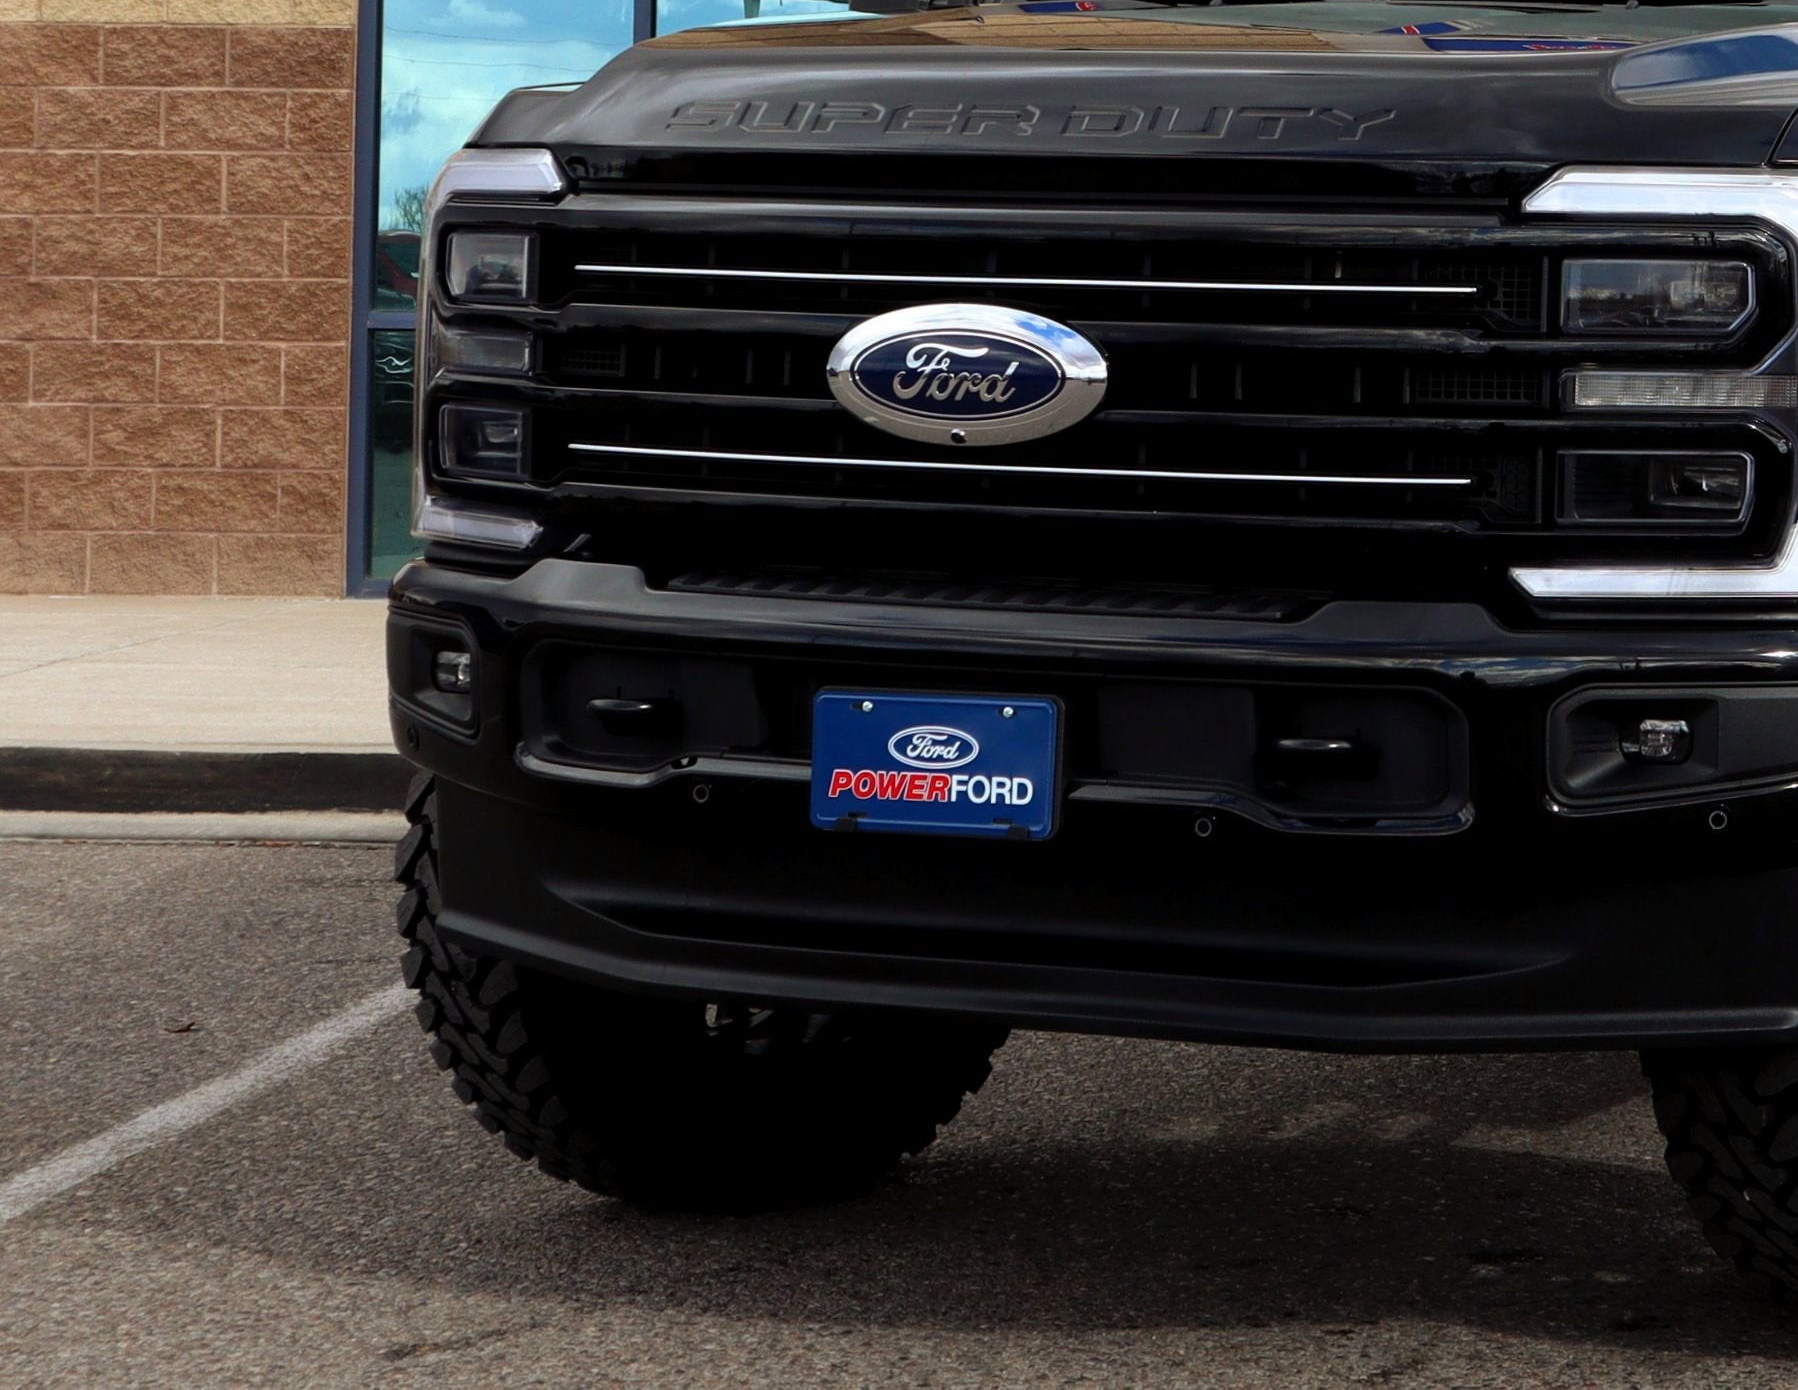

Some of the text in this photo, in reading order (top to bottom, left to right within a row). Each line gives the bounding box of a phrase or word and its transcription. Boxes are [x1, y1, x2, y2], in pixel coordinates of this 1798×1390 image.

[665, 99, 1398, 142] SUPER DUTY
[892, 342, 1020, 403] Ford
[906, 733, 962, 760] Ford
[828, 768, 1034, 806] POWERFORD
